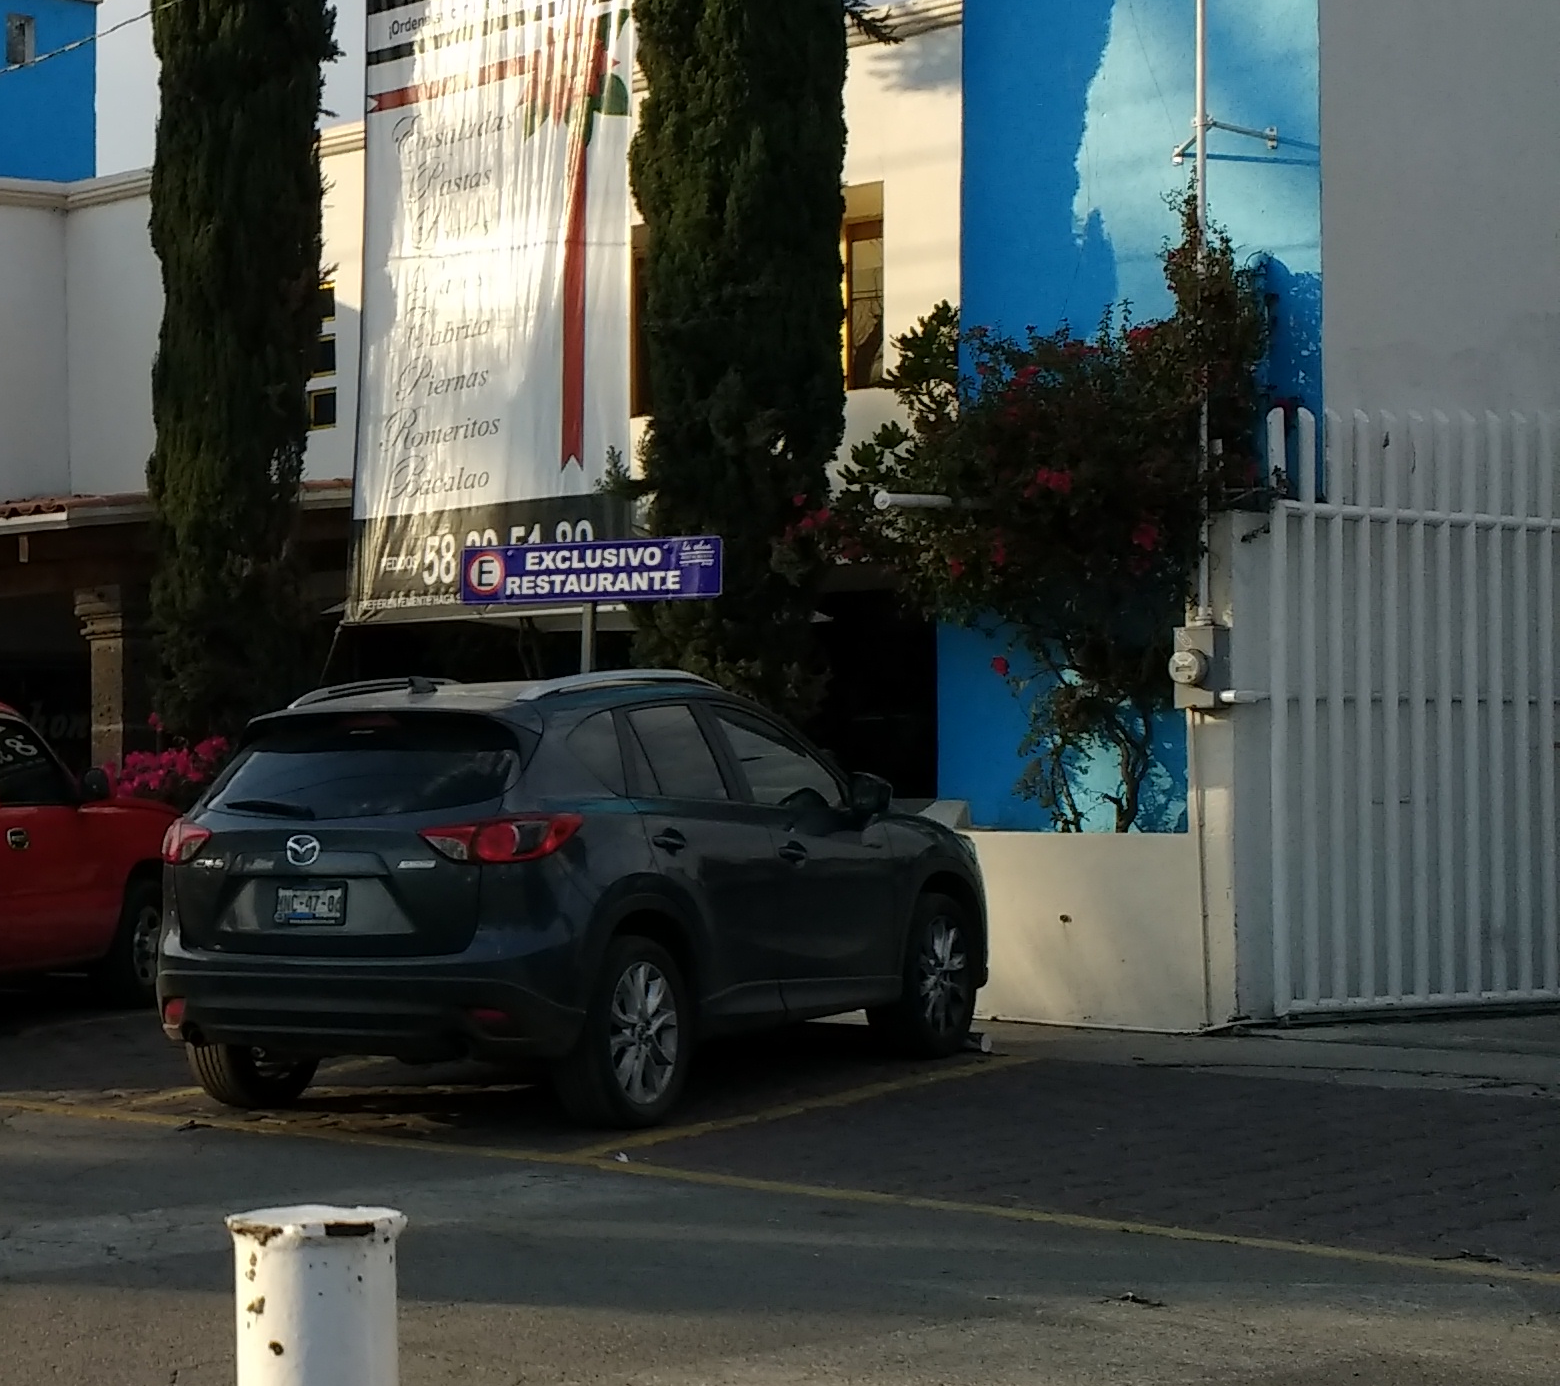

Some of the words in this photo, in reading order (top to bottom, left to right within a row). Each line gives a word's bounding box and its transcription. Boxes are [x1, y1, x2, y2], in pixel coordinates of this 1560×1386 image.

[408, 156, 492, 203] Pastas
[396, 356, 489, 401] Piernas
[379, 406, 501, 452] Romeritos
[386, 454, 490, 499] Bacalao
[423, 533, 456, 586] 58
[478, 559, 494, 587] E
[525, 546, 662, 571] EXCLUSIVO
[505, 570, 681, 596] RESTAURANTE
